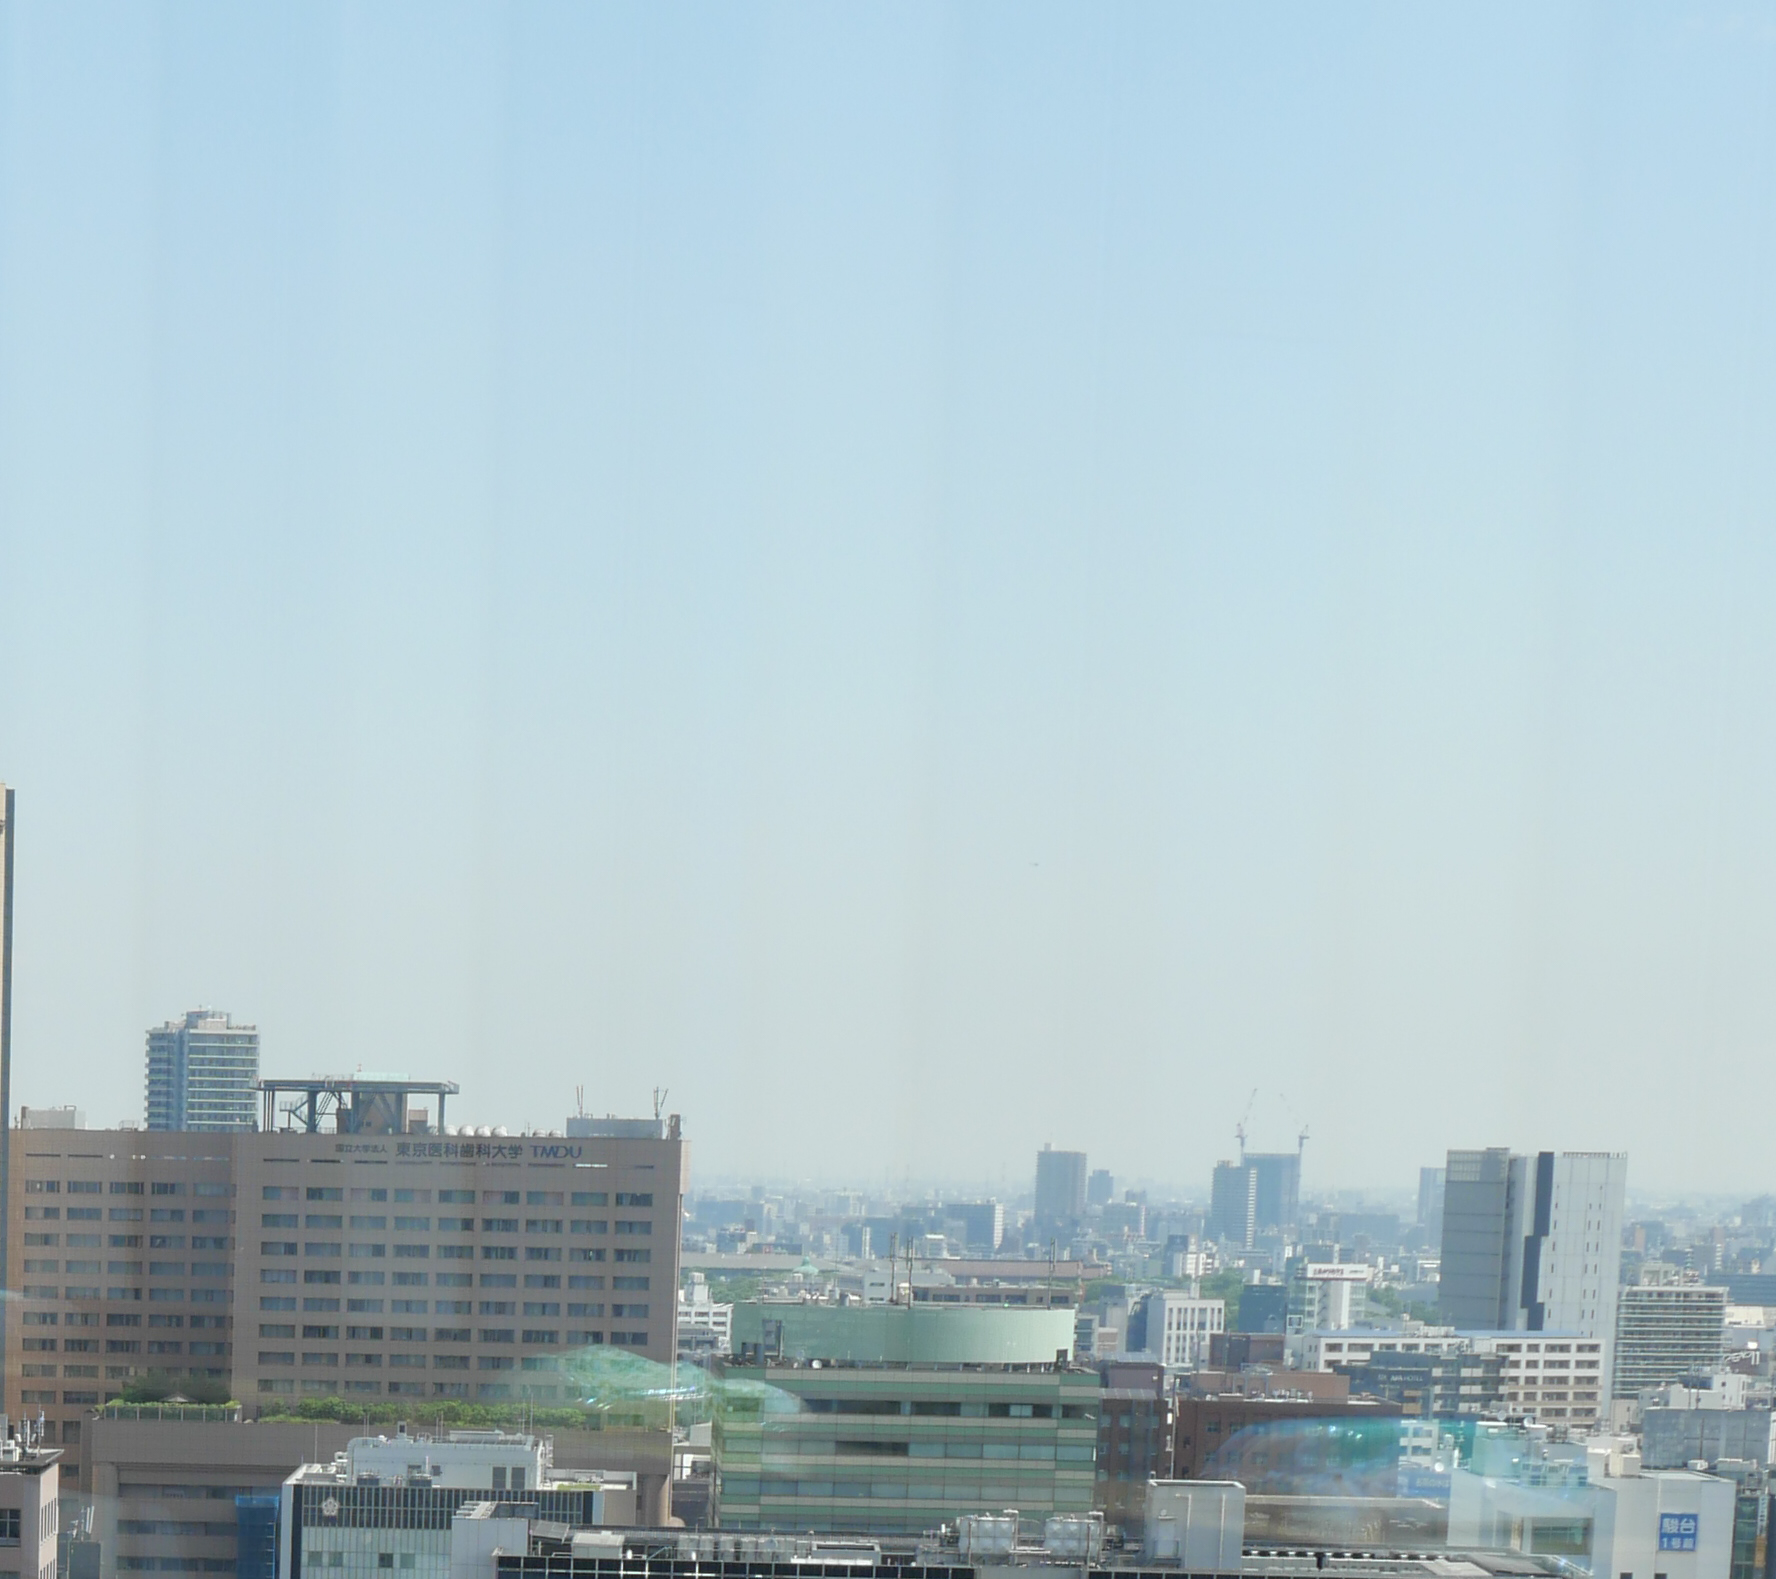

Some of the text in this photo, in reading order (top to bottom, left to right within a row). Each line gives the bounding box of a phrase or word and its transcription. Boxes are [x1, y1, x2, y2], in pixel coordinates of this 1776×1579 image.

[395, 1141, 524, 1160] 東京医科歯科大学
[529, 1144, 583, 1160] TMDU
